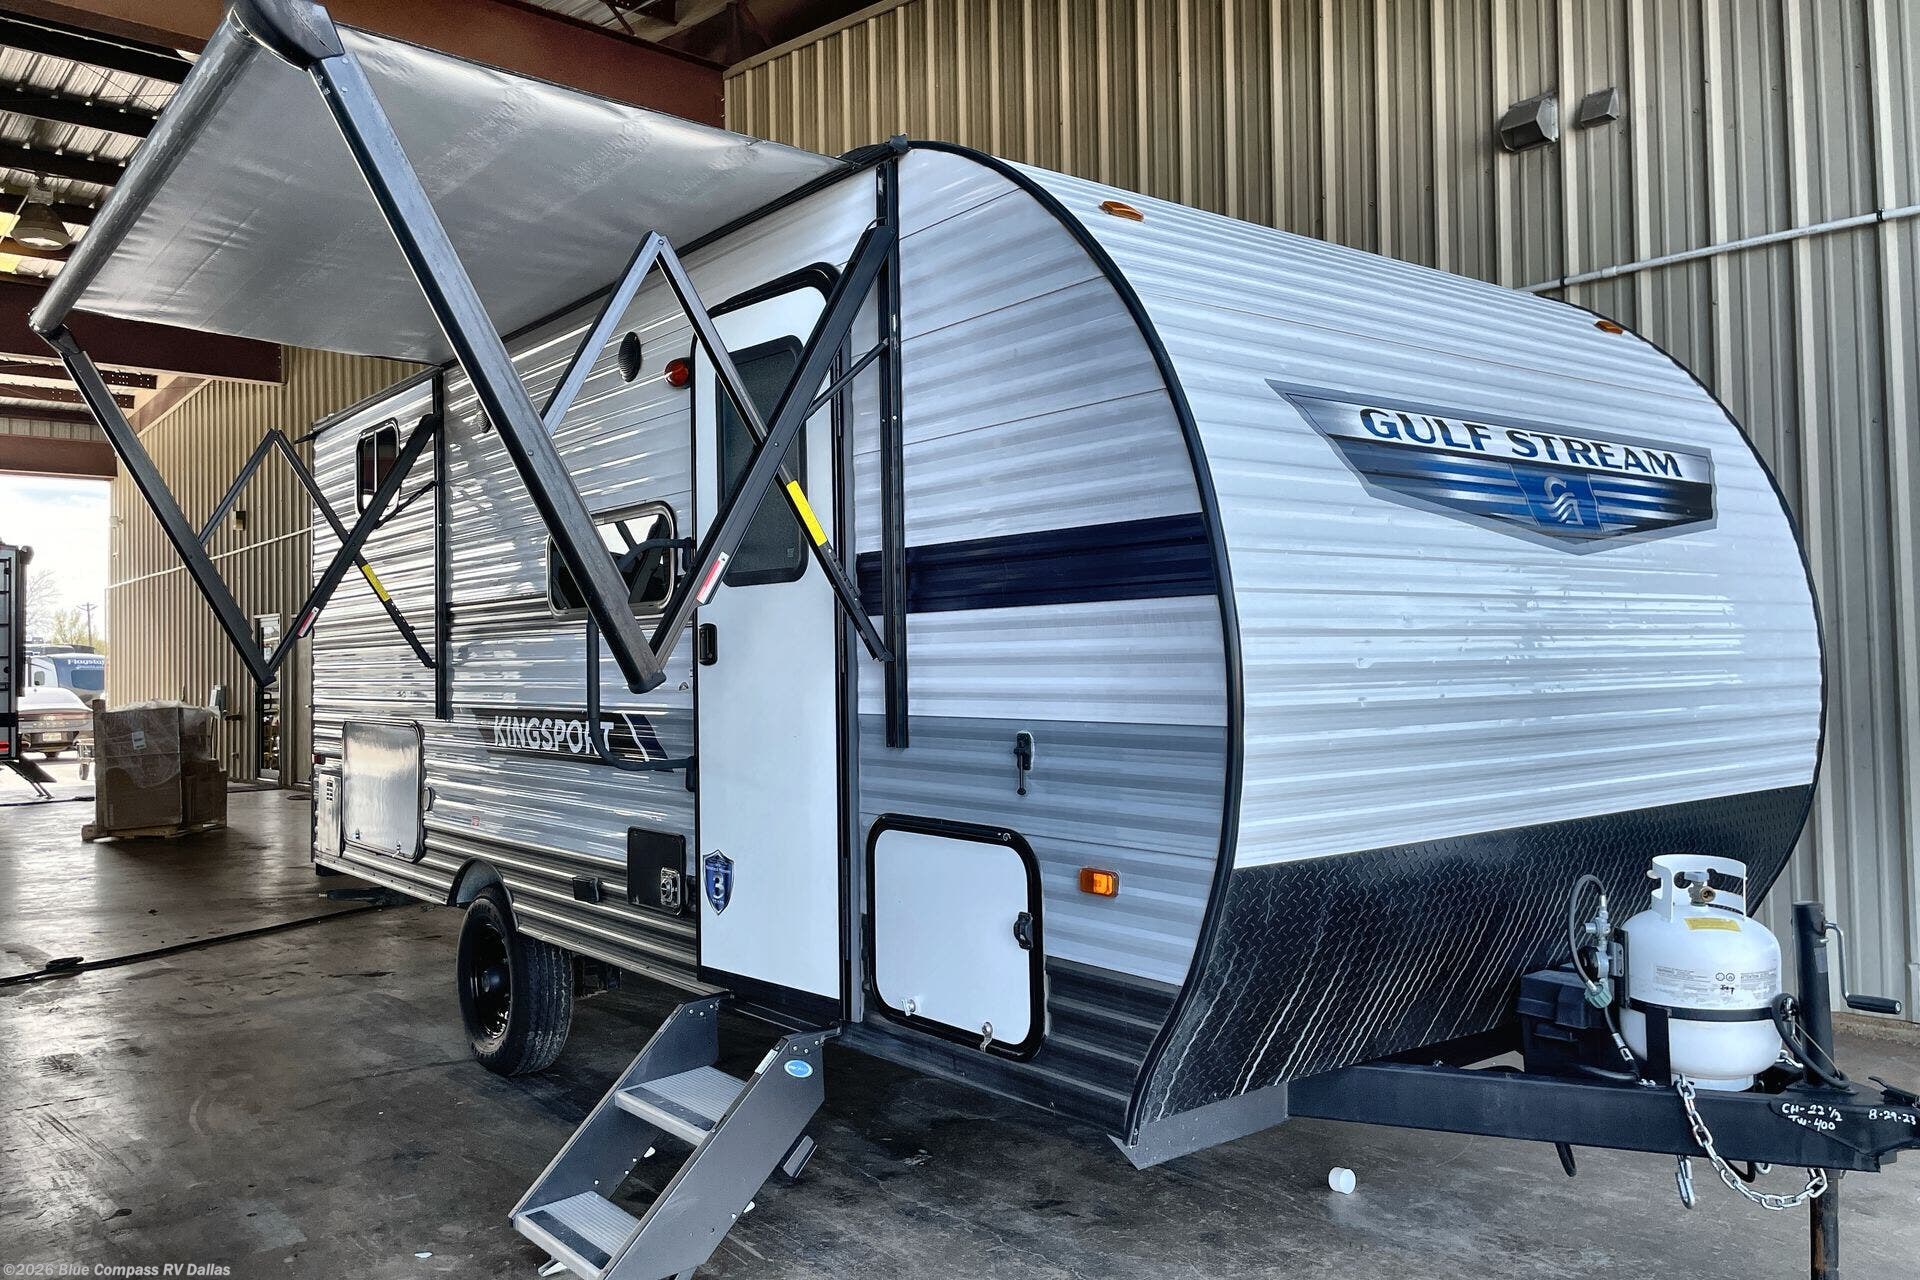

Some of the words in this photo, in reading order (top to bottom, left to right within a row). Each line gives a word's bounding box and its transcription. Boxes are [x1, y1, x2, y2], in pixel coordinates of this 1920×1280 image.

[1359, 408, 1493, 451] GULF
[1505, 429, 1683, 478] STREAM
[712, 872, 725, 899] 3
